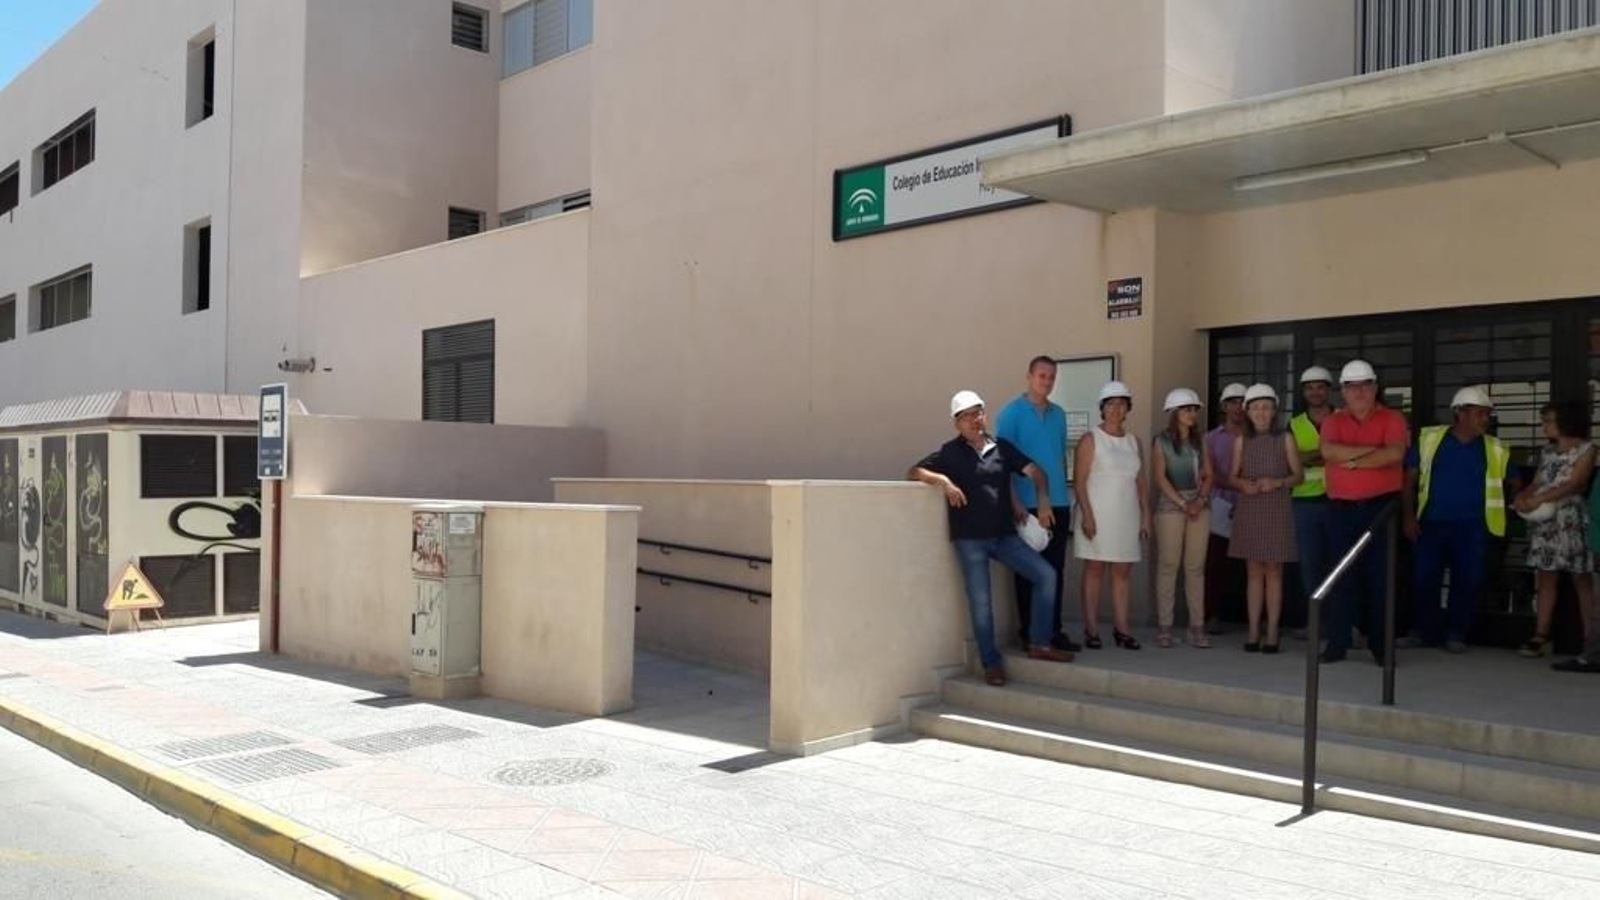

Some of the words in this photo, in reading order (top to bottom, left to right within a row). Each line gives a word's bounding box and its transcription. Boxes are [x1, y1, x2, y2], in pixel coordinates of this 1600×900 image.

[892, 172, 921, 191] Colegio
[922, 169, 932, 185] de
[933, 161, 974, 182] Educación
